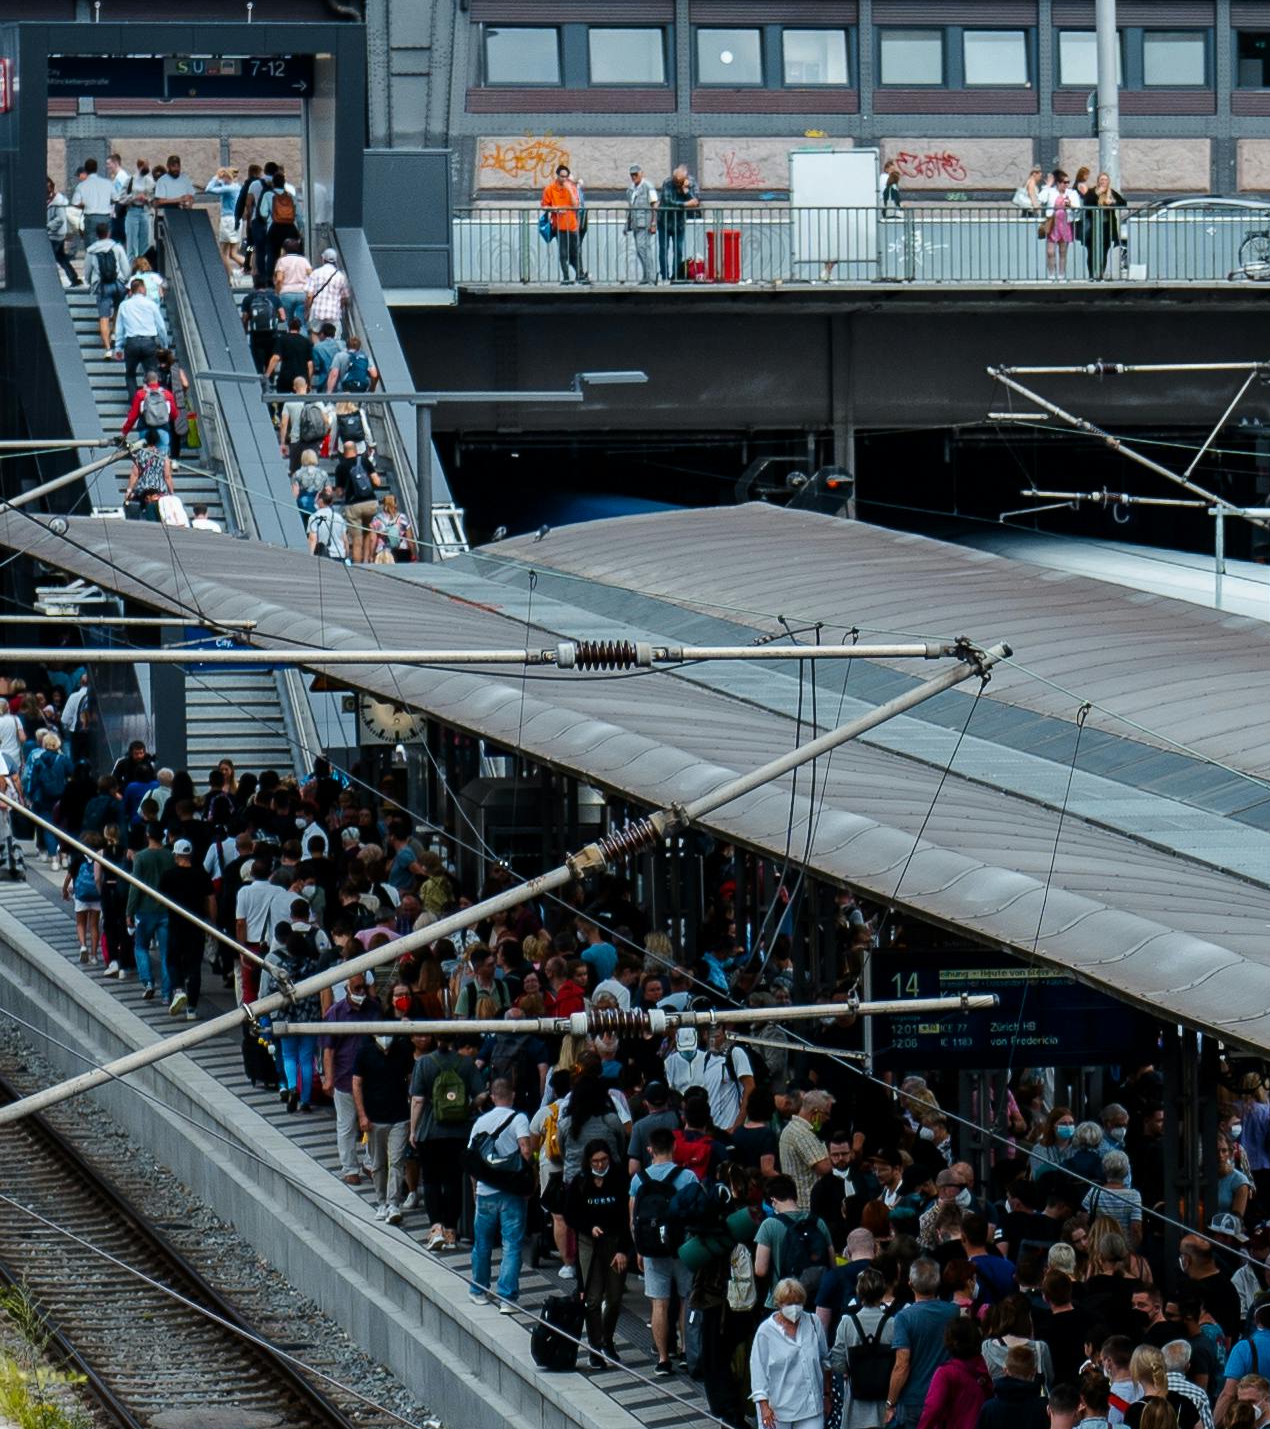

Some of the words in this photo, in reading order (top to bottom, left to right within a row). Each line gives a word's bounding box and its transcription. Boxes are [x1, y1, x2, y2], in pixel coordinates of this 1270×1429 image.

[251, 61, 286, 77] 7-12
[890, 971, 920, 998] 14
[989, 1021, 1019, 1033] Zürich
[990, 1038, 1006, 1047] von
[1010, 1035, 1058, 1047] Fredericia
